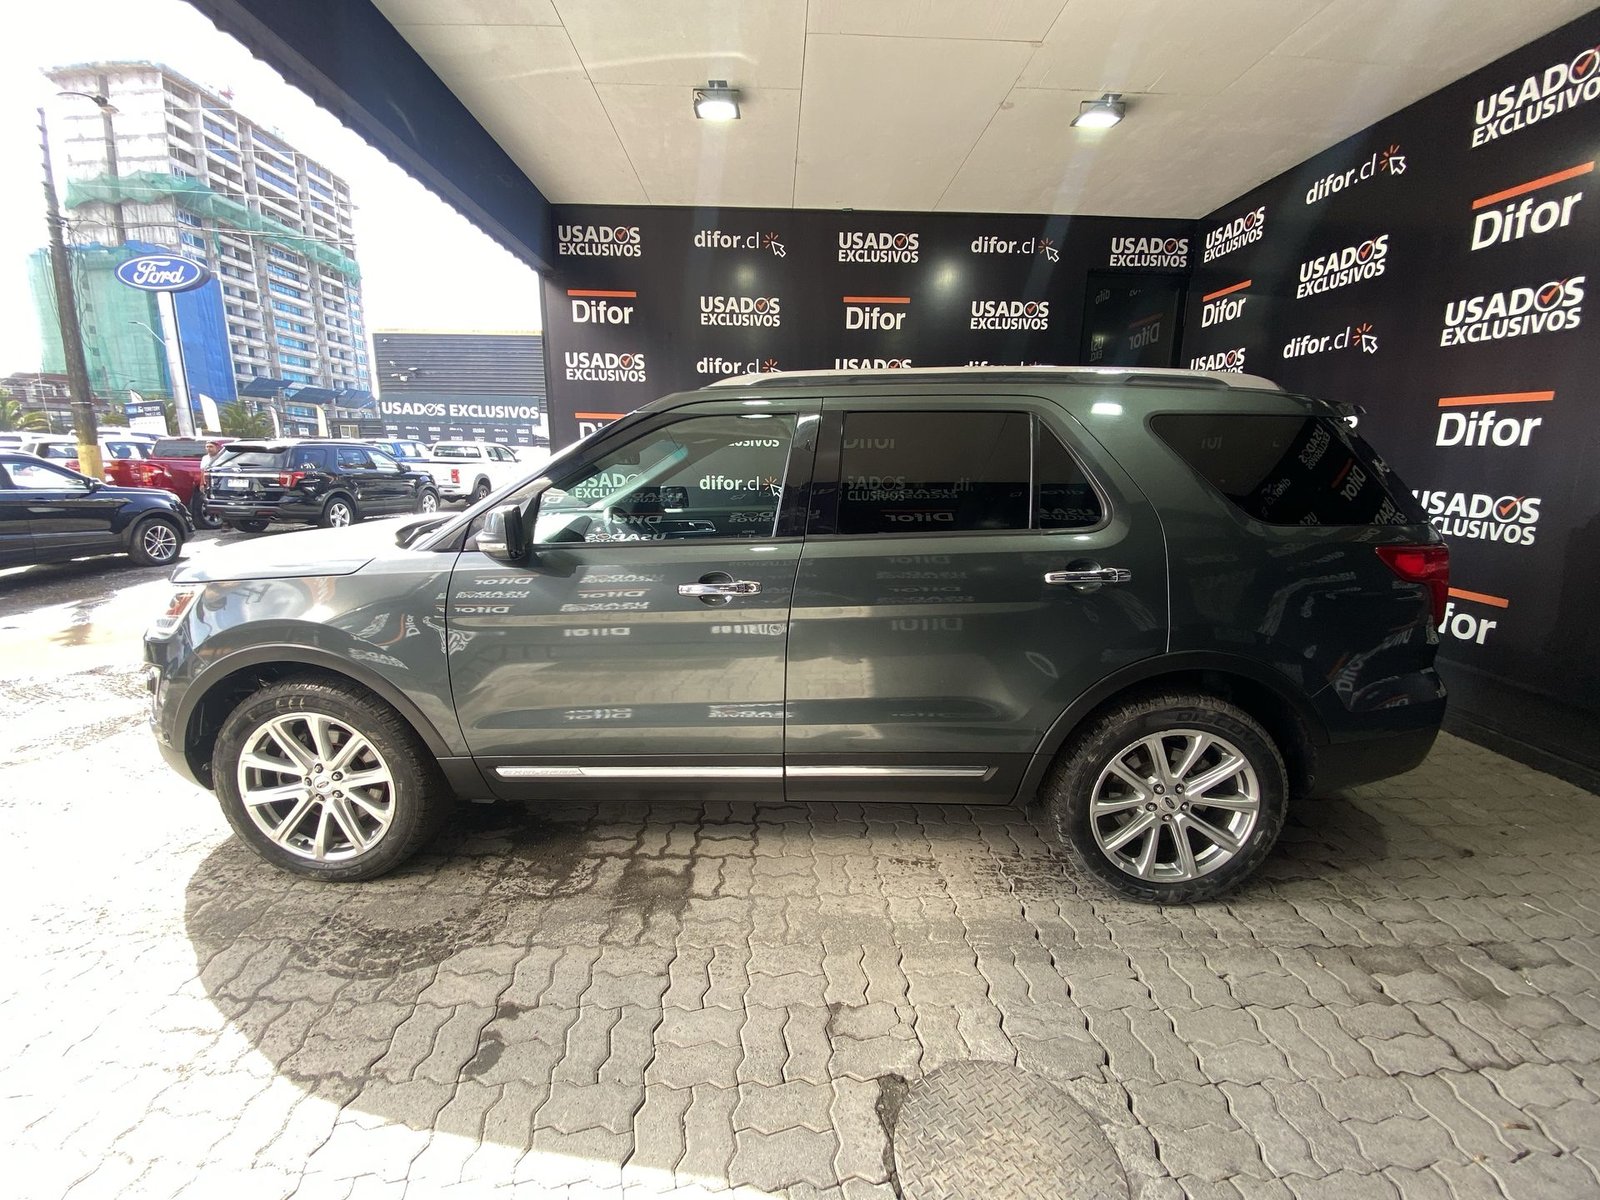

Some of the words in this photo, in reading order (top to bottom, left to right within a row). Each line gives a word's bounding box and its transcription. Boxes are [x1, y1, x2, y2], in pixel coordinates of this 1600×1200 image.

[1475, 49, 1600, 125] USADO
[1306, 153, 1376, 204] difor.cl
[1205, 206, 1265, 250] USADOS
[1471, 192, 1583, 251] Difor
[558, 225, 641, 244] USADOS
[694, 230, 760, 249] difor.cl
[838, 231, 919, 250] USADOS
[970, 236, 1035, 254] difor.cl
[1203, 225, 1264, 264] EXCLUSIVOS
[558, 243, 642, 258] EXCLUSIVOS
[838, 249, 919, 264] EXCLUSIVOS
[1110, 237, 1189, 255] USADOS
[1109, 254, 1188, 268] EXCLUSIVOS
[1299, 234, 1389, 284] USADOS
[132, 261, 185, 284] Ford
[1296, 259, 1386, 299] EXCLUSIVOS
[571, 300, 634, 324] Difor
[700, 295, 781, 314] USADOS
[971, 301, 1050, 318] USADOS
[1445, 276, 1586, 327] USADOS
[700, 313, 781, 328] EXCLUSIVOS
[845, 306, 907, 330] Difor
[1201, 297, 1247, 328] Difor
[970, 317, 1049, 331] EXCLUSIVOS
[1440, 307, 1582, 347] EXCLUSIVOS
[1283, 326, 1352, 359] difor.cl
[565, 351, 646, 370] USADOS
[696, 357, 760, 374] difor.cl
[1190, 347, 1246, 372] USADOS
[565, 368, 647, 382] EXCLUSIVOS
[381, 402, 446, 417] USADOS
[449, 404, 540, 419] EXCLUSIVOS
[1435, 410, 1542, 446] Difor
[699, 475, 760, 491] difor.cl
[847, 475, 905, 490] SADOS
[1428, 515, 1537, 546] CLUSIVOS
[1438, 602, 1497, 645] for
